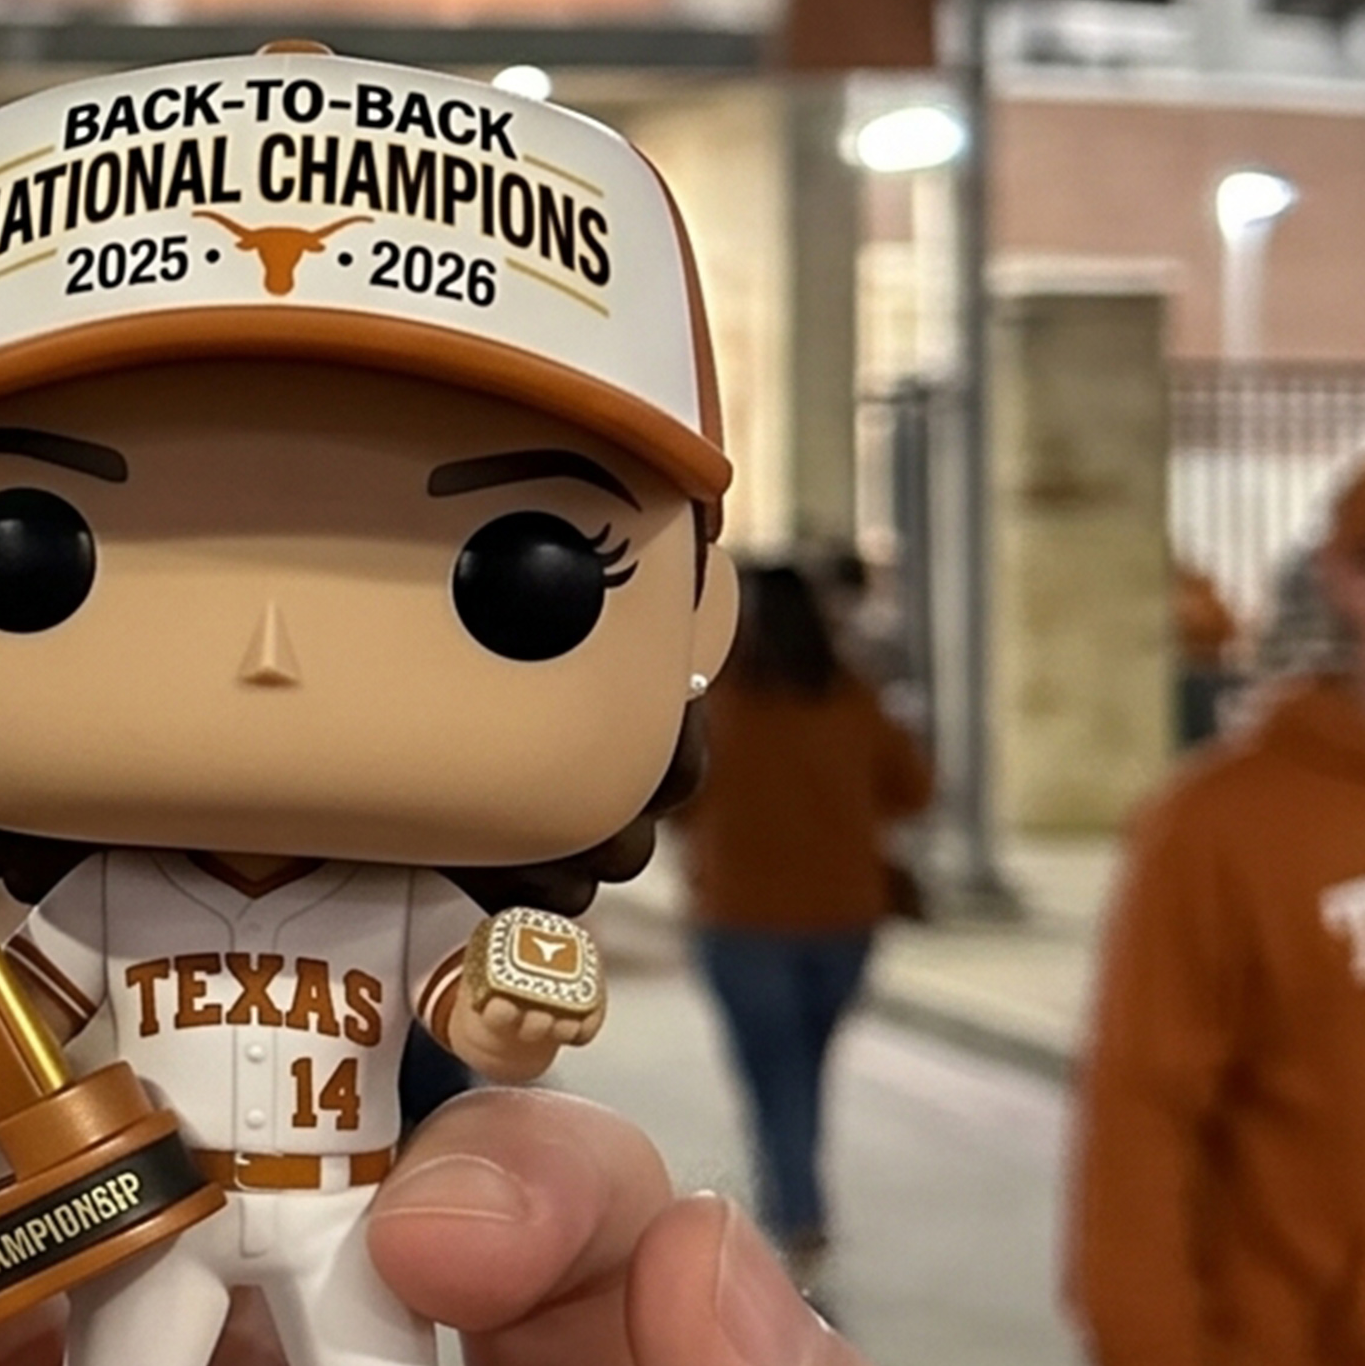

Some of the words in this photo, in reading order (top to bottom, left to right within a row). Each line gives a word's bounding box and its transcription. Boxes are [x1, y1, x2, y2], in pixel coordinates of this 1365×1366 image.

[63, 78, 518, 160] BACK-TO-BACK
[259, 132, 612, 288] CHAMPIONS
[66, 235, 189, 295] 2025
[369, 241, 497, 308] 2026
[125, 953, 382, 1047] TEXAS
[291, 1057, 360, 1131] 14
